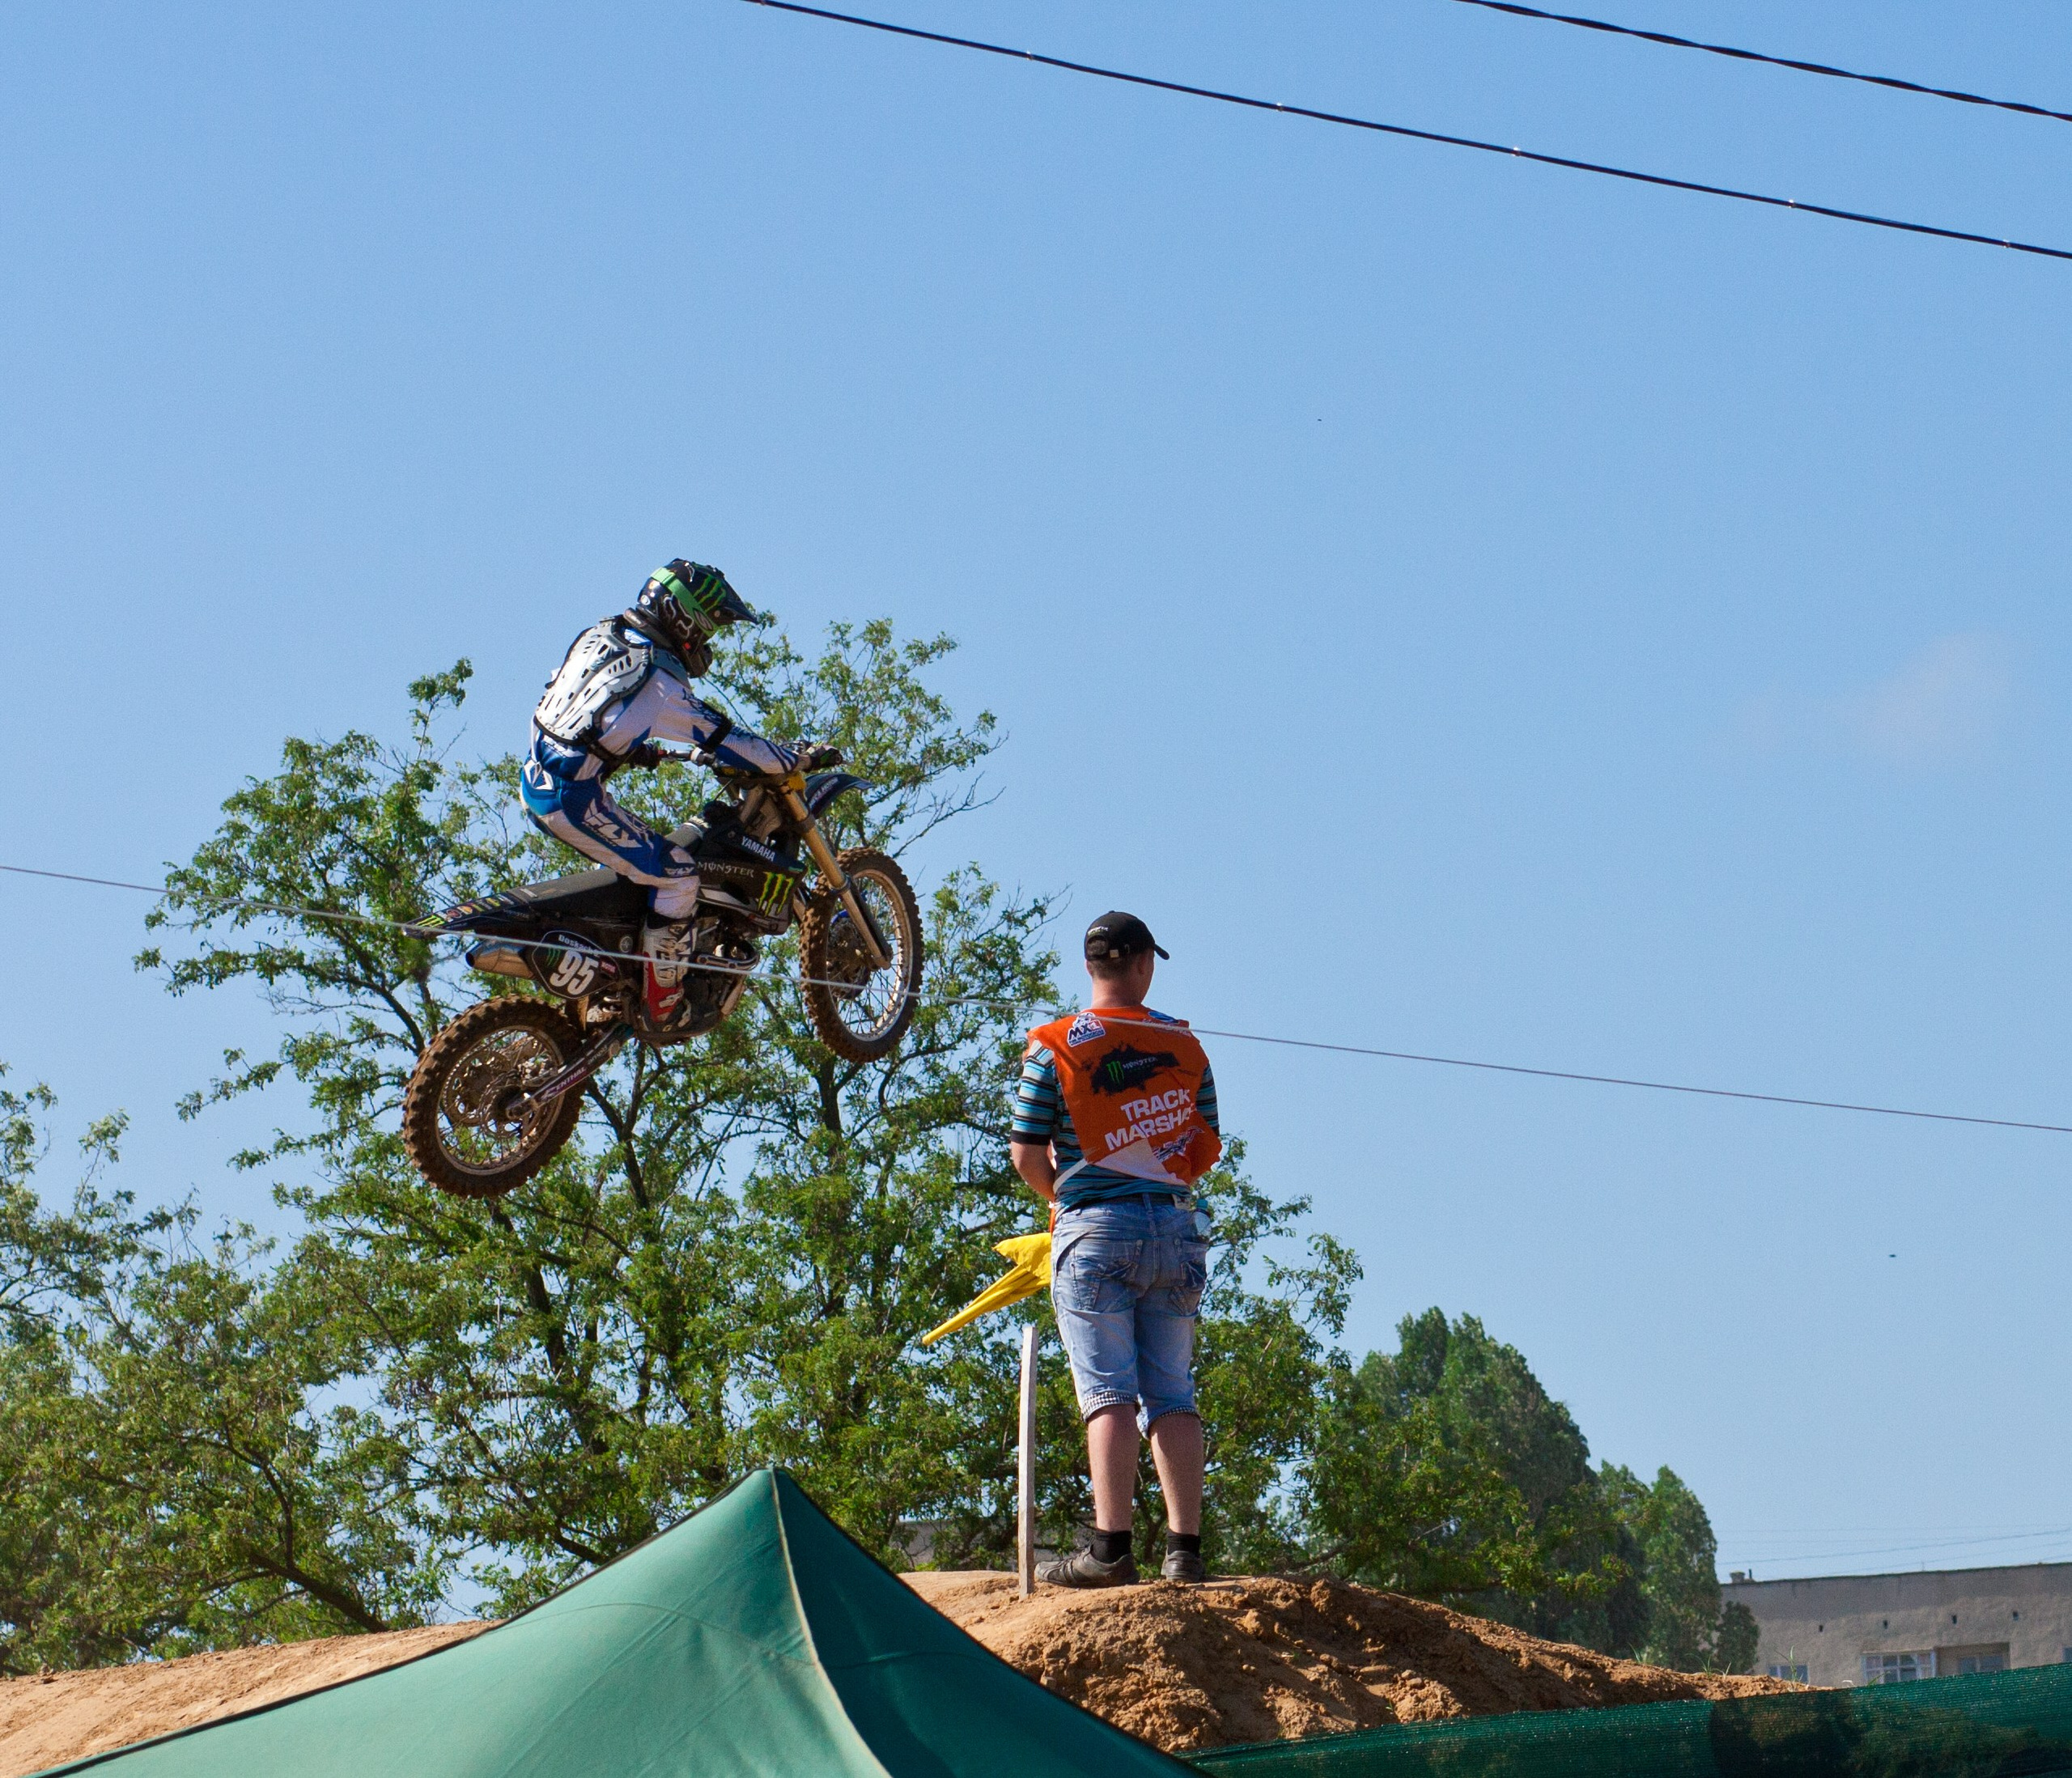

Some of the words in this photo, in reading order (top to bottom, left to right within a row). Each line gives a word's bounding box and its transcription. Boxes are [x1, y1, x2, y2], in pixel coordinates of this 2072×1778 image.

[741, 835, 776, 862] YAMAHA
[697, 860, 754, 878] MONSTER
[550, 948, 600, 995] 95
[1121, 1088, 1191, 1122] TRACK
